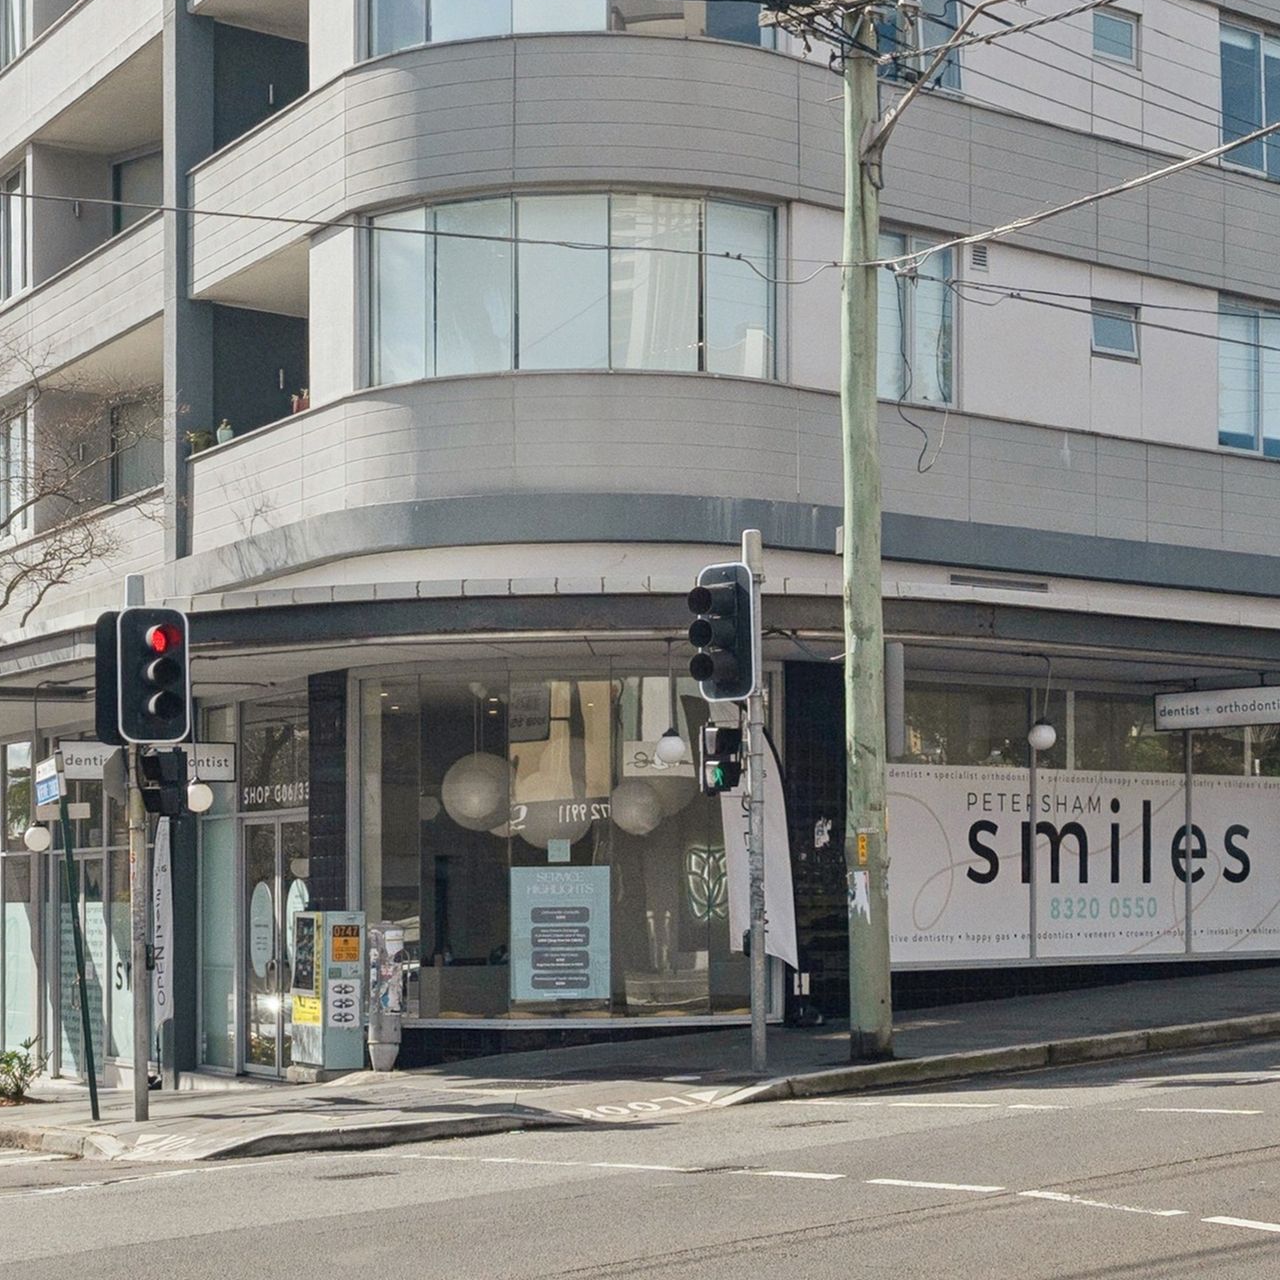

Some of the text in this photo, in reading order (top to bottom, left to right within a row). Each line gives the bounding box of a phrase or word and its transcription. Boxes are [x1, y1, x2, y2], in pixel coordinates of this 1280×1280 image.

[1159, 705, 1200, 717] dentist
[65, 753, 108, 767] denti
[889, 768, 923, 778] dentist
[934, 771, 978, 782] specialist
[243, 785, 271, 805] SHOP
[967, 798, 1252, 884] smiles
[536, 871, 585, 882] SERVICE
[1050, 896, 1158, 920] 8320 0550
[333, 926, 359, 937] 0747
[912, 933, 955, 944] dentistry
[965, 931, 992, 943] happy
[995, 933, 1011, 943] gas
[1084, 931, 1116, 939] veneers
[1125, 929, 1154, 938] crowns
[559, 1096, 696, 1120] LOOK
